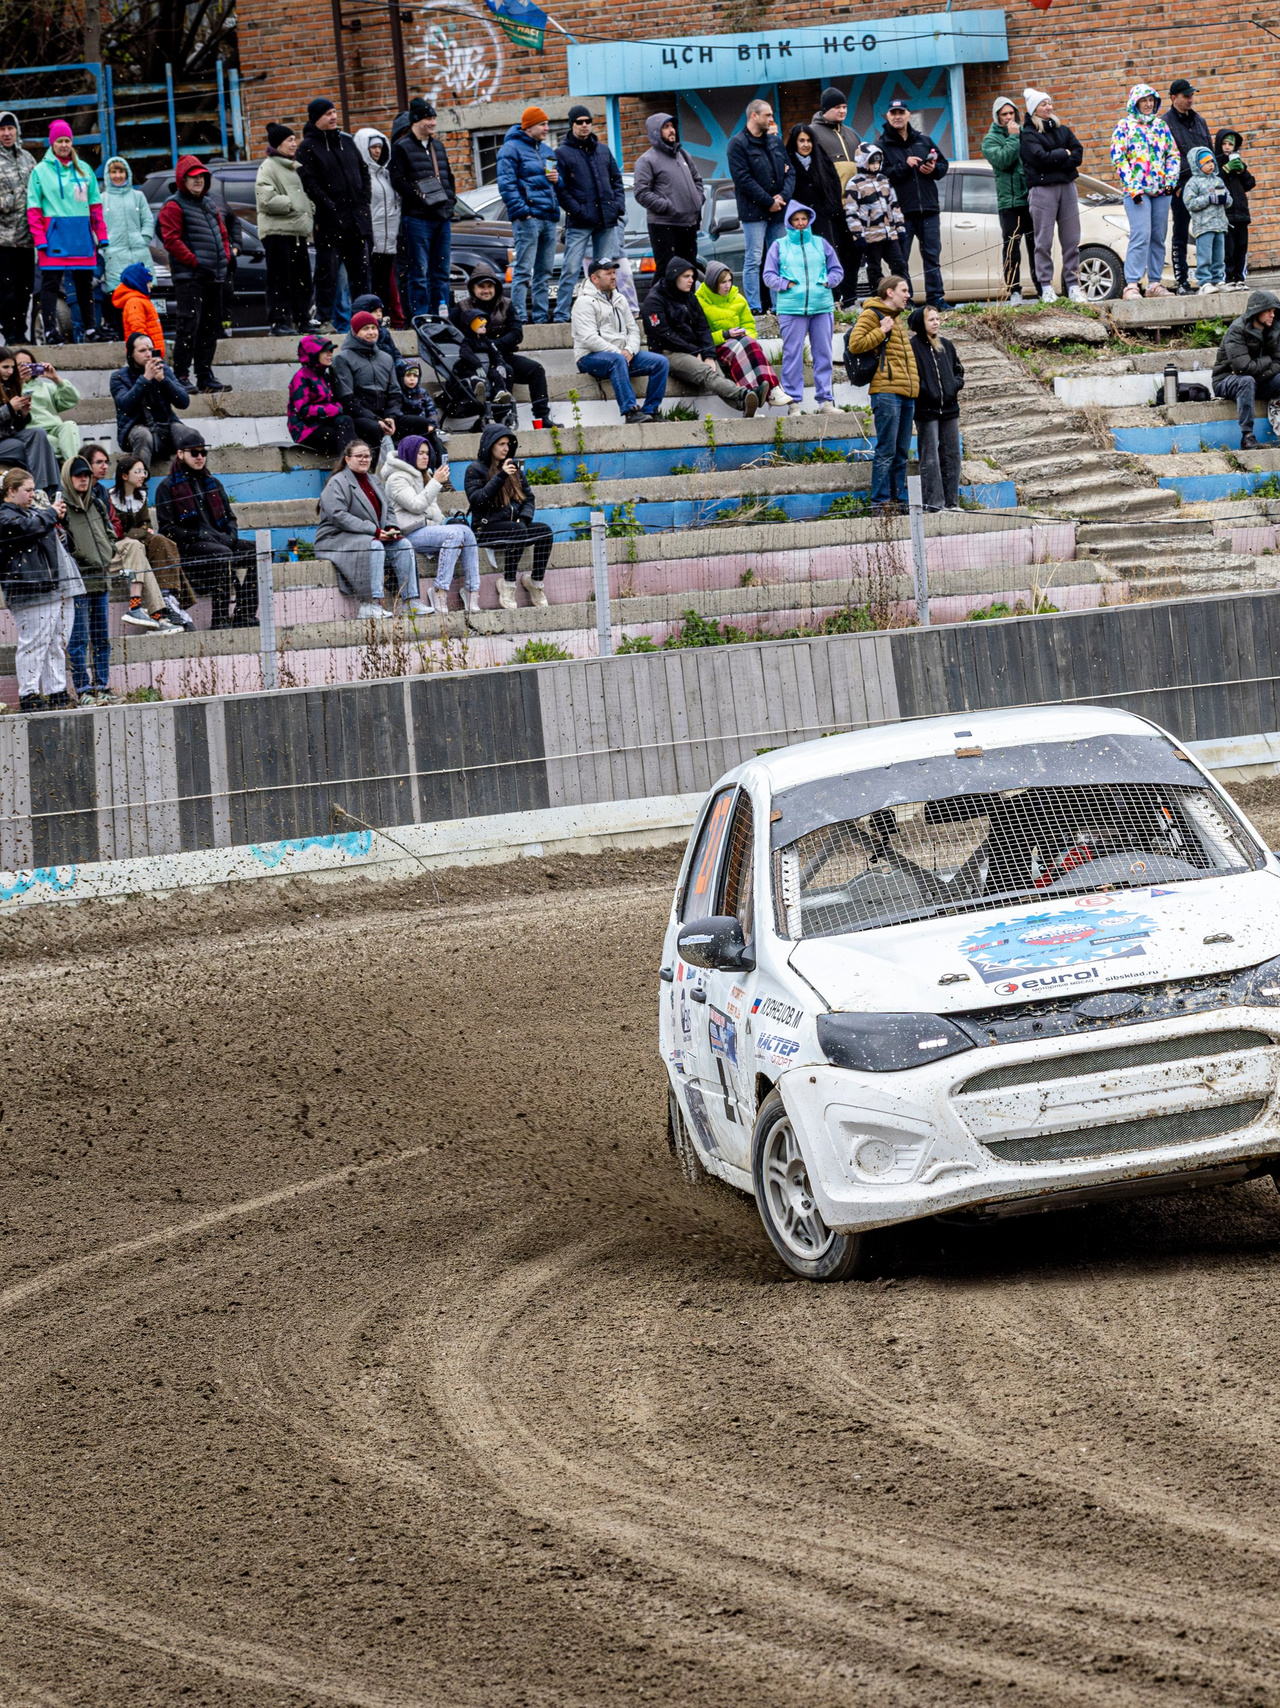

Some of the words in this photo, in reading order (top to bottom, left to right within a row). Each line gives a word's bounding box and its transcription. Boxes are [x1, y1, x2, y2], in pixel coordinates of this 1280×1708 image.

[662, 46, 713, 69] ЦСН
[738, 40, 792, 61] ВПК
[824, 34, 877, 54] НСО
[1022, 967, 1099, 989] eurol
[1105, 970, 1159, 982] sibsklad.ru
[756, 1032, 801, 1057] МАСТЕР
